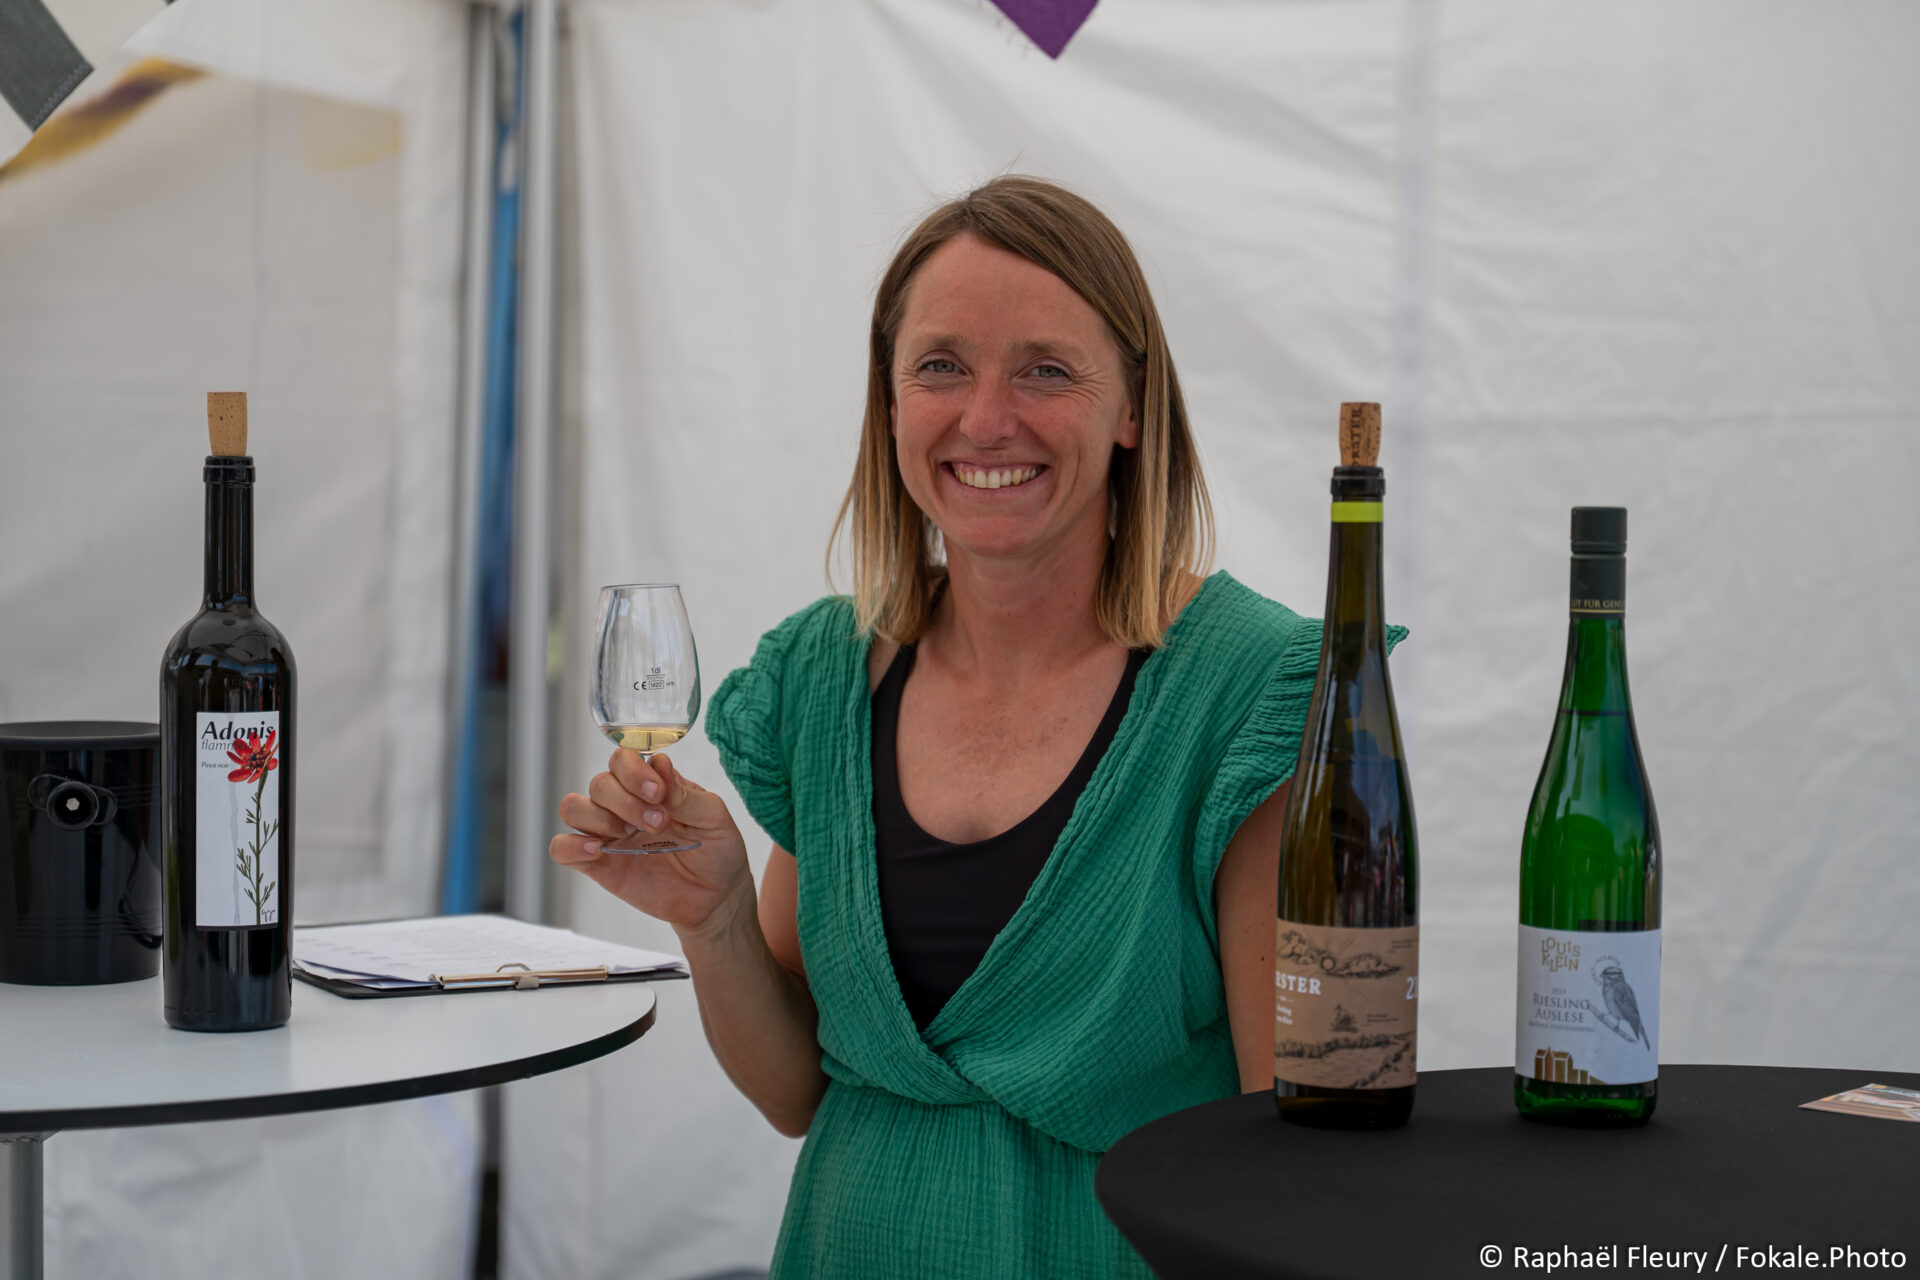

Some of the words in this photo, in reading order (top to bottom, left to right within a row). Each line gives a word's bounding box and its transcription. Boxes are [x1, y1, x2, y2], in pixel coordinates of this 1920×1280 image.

[201, 720, 275, 740] Adonis
[201, 761, 217, 769] Pinot
[1541, 937, 1582, 958] LOUIS
[1541, 952, 1580, 973] KLEIN
[1532, 992, 1592, 1010] RIESLING
[1535, 1007, 1585, 1023] AUSLESE
